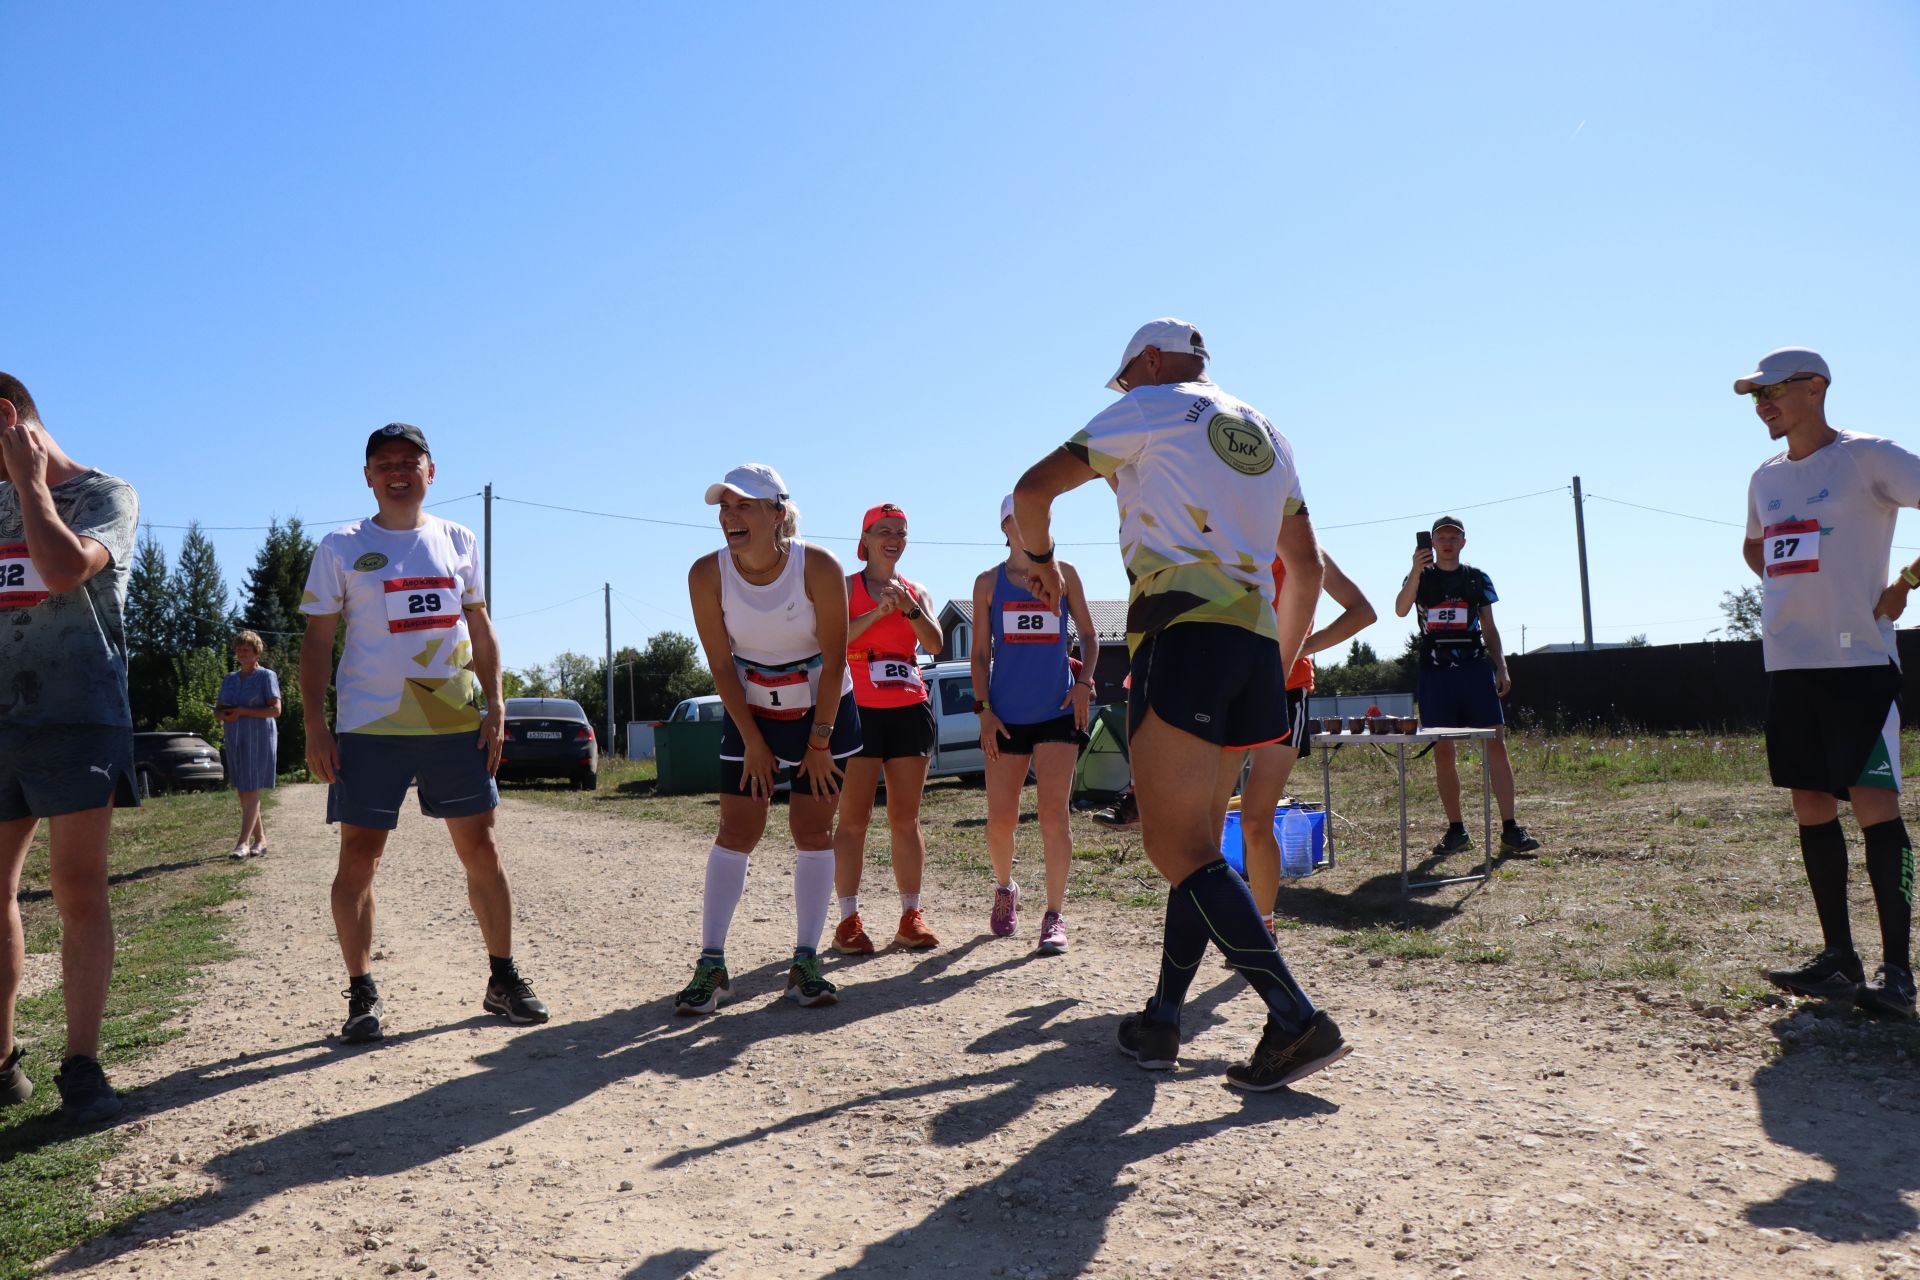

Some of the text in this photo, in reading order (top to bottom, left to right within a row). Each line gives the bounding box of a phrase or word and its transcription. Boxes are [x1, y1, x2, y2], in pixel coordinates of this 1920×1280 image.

[1774, 538, 1800, 559] 27
[408, 593, 442, 614] 29
[1017, 614, 1044, 630] 28
[1438, 610, 1456, 621] 25
[885, 663, 909, 678] 26
[769, 690, 782, 707] 1
